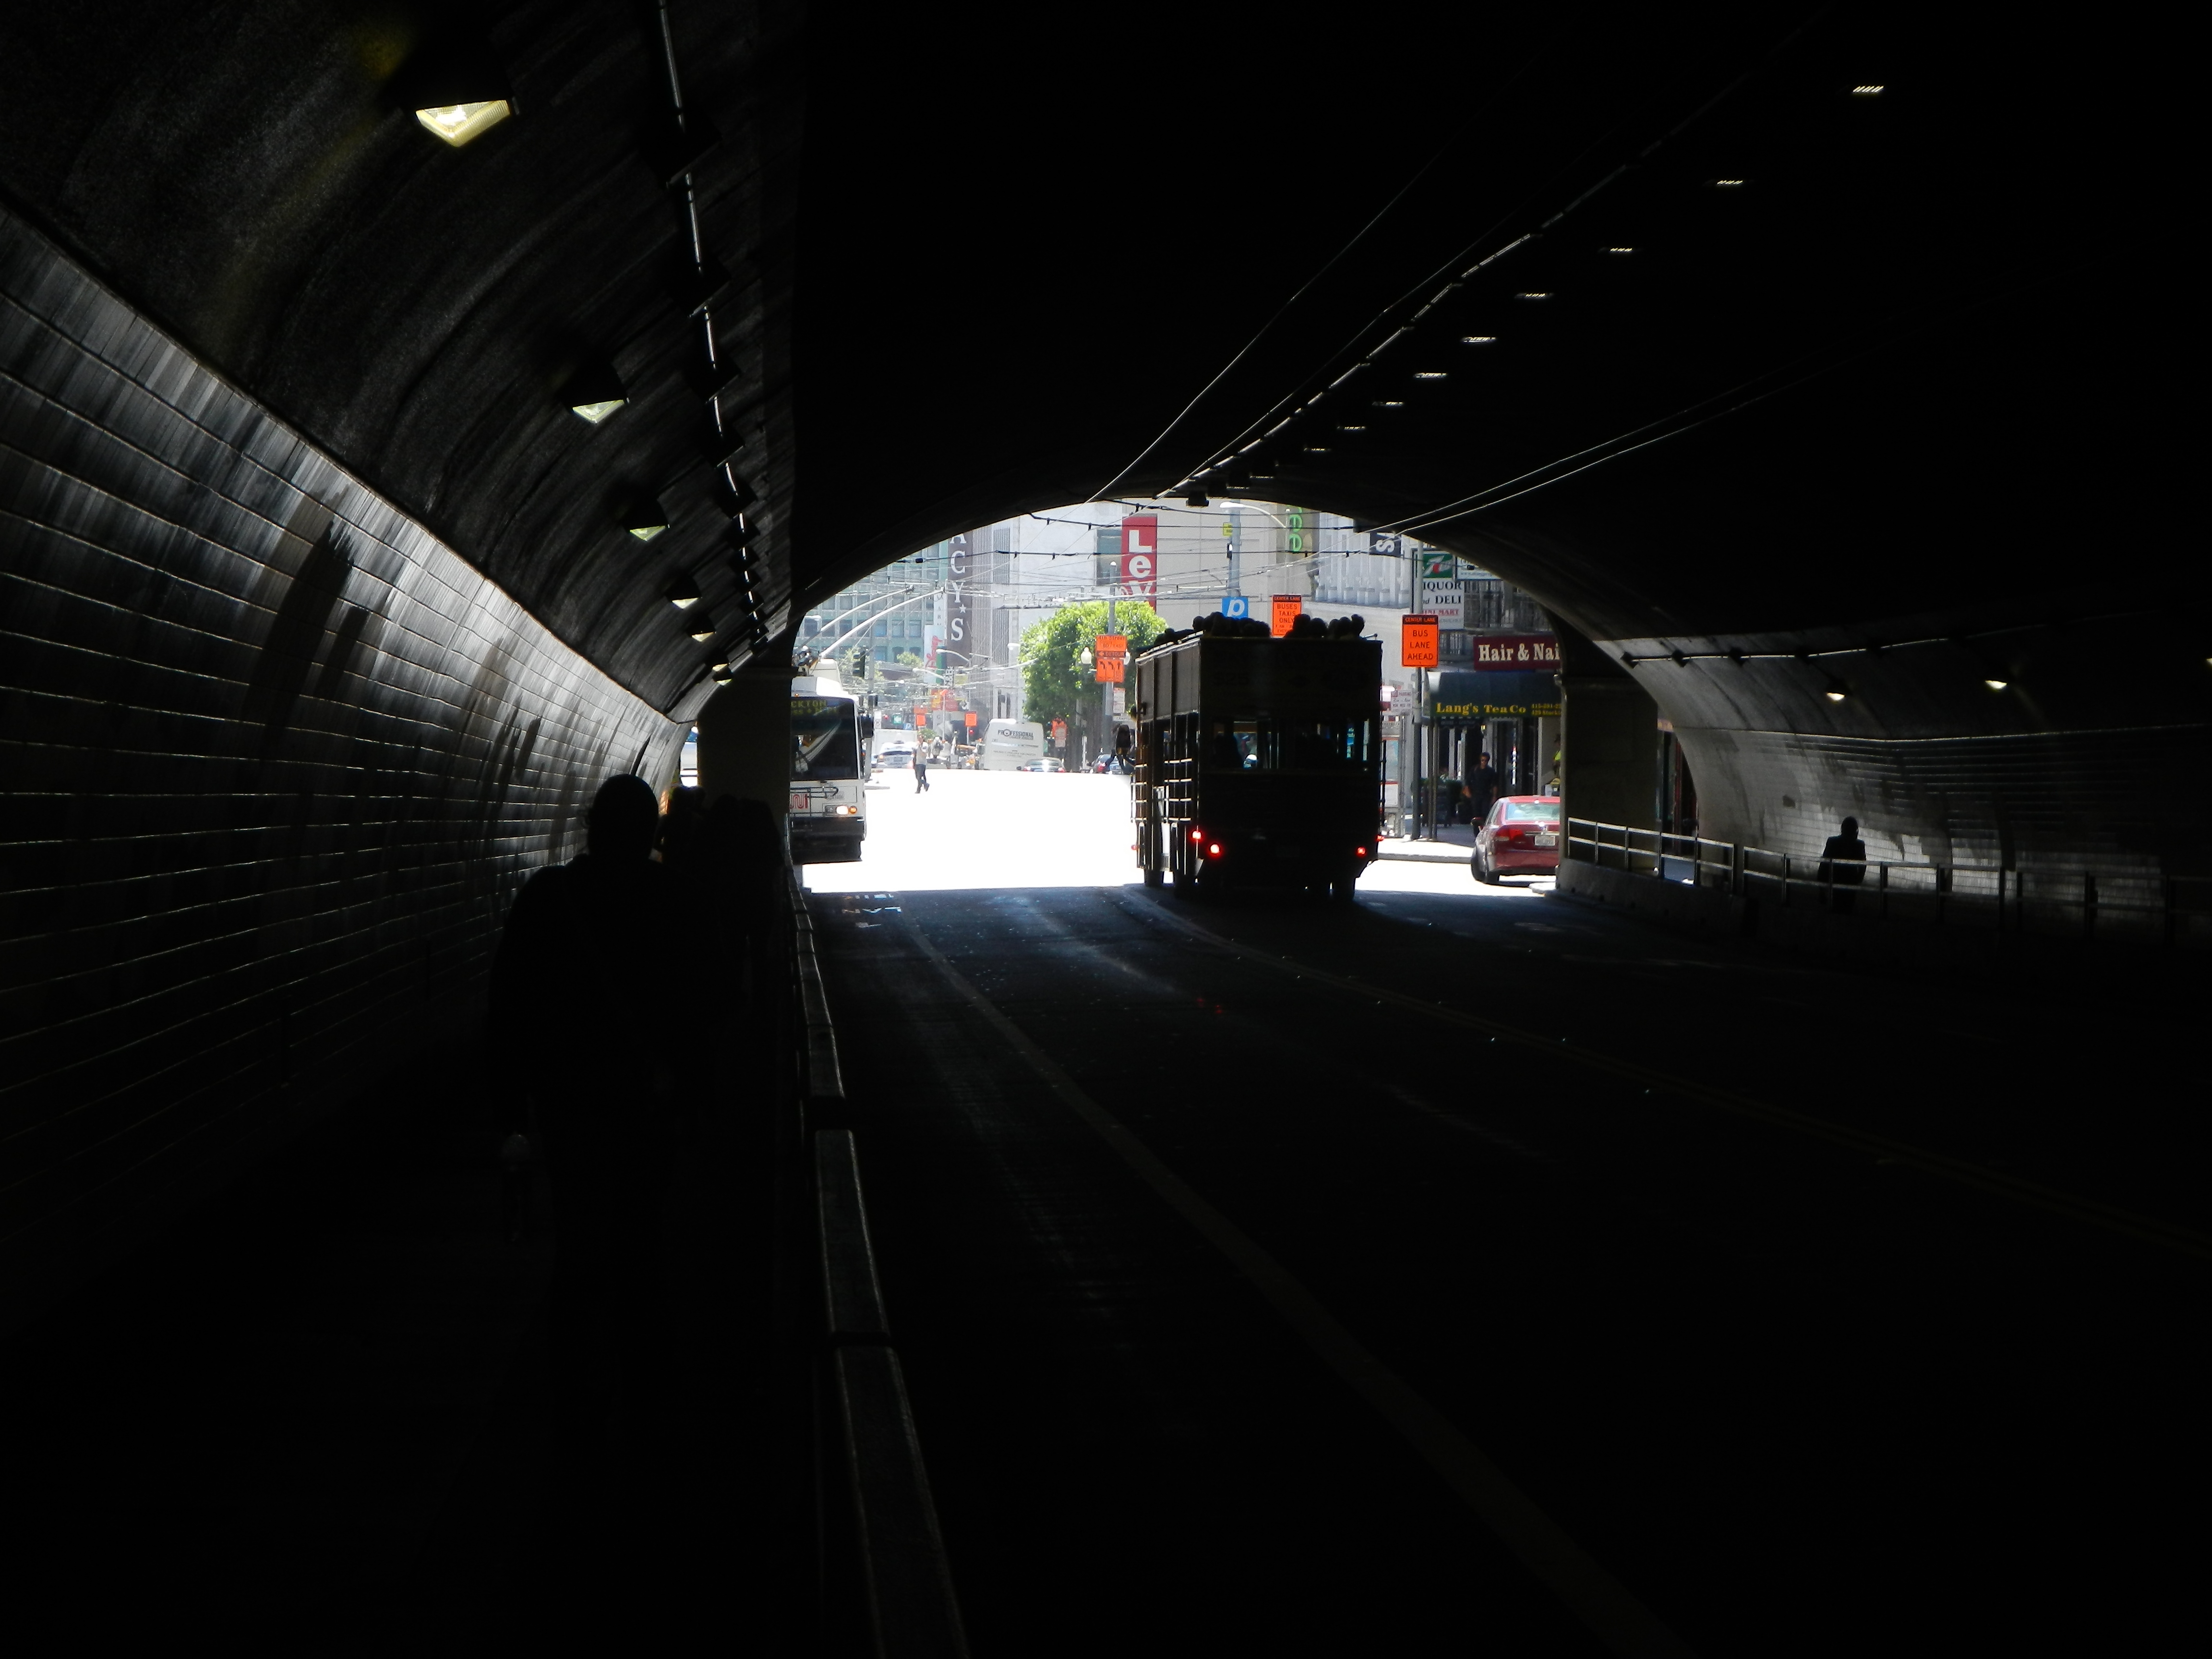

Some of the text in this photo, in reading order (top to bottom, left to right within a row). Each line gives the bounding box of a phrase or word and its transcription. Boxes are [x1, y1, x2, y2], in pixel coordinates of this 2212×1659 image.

[1423, 581, 1462, 592] IQUOR
[1435, 595, 1461, 604] DELI
[1478, 643, 1514, 661] Hair
[1517, 643, 1530, 661] &
[1436, 702, 1479, 715] Lang's
[998, 729, 1034, 737] PROFESSIONAL
